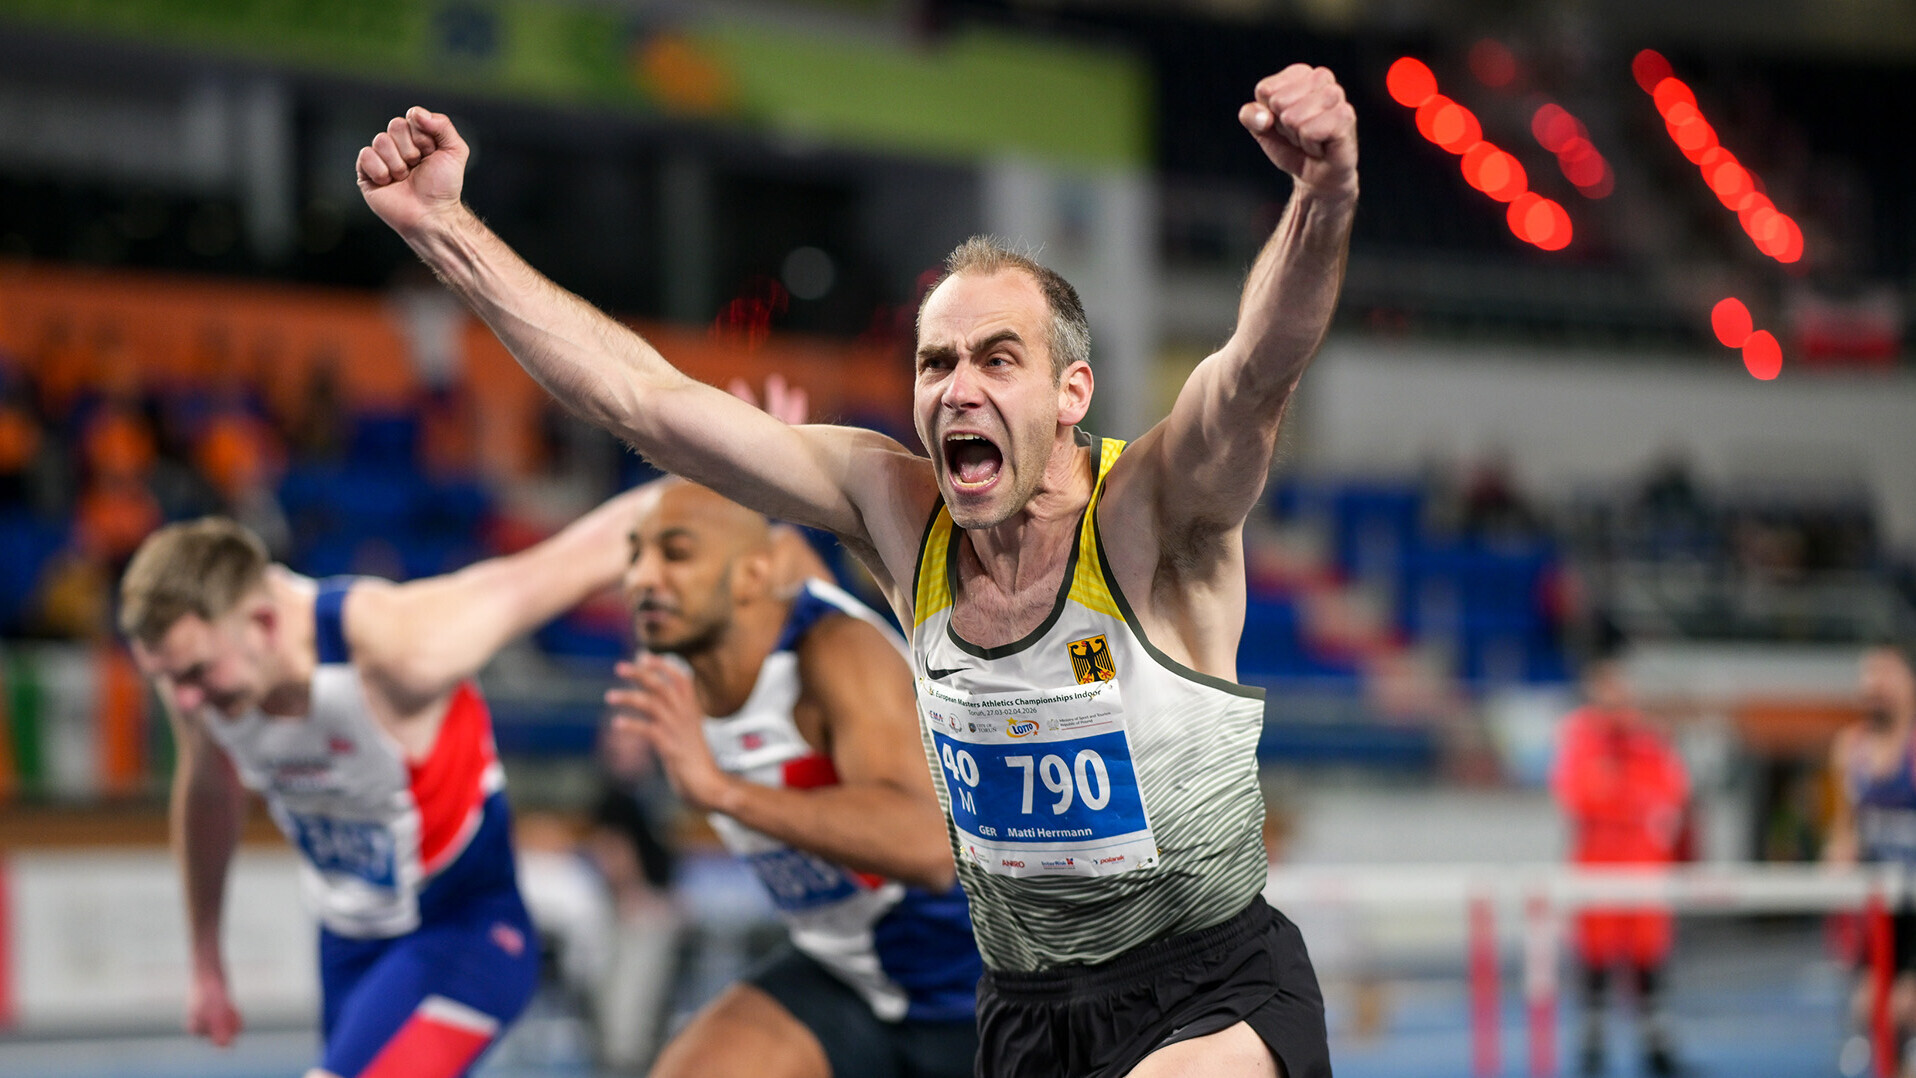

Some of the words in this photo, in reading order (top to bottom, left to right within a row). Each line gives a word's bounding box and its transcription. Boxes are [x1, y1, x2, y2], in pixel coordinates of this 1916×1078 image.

[936, 691, 957, 702] European
[957, 698, 981, 708] Masters
[1015, 694, 1073, 706] Championships
[1074, 689, 1101, 699] Indoor
[986, 707, 1037, 716] 27.03-02.04.2026
[1011, 722, 1034, 735] LOTTO
[942, 742, 980, 788] 40
[1004, 748, 1111, 816] 790
[958, 786, 977, 816] M
[978, 824, 998, 837] GER
[1007, 827, 1036, 838] Matti
[1037, 827, 1093, 838] Herrmann
